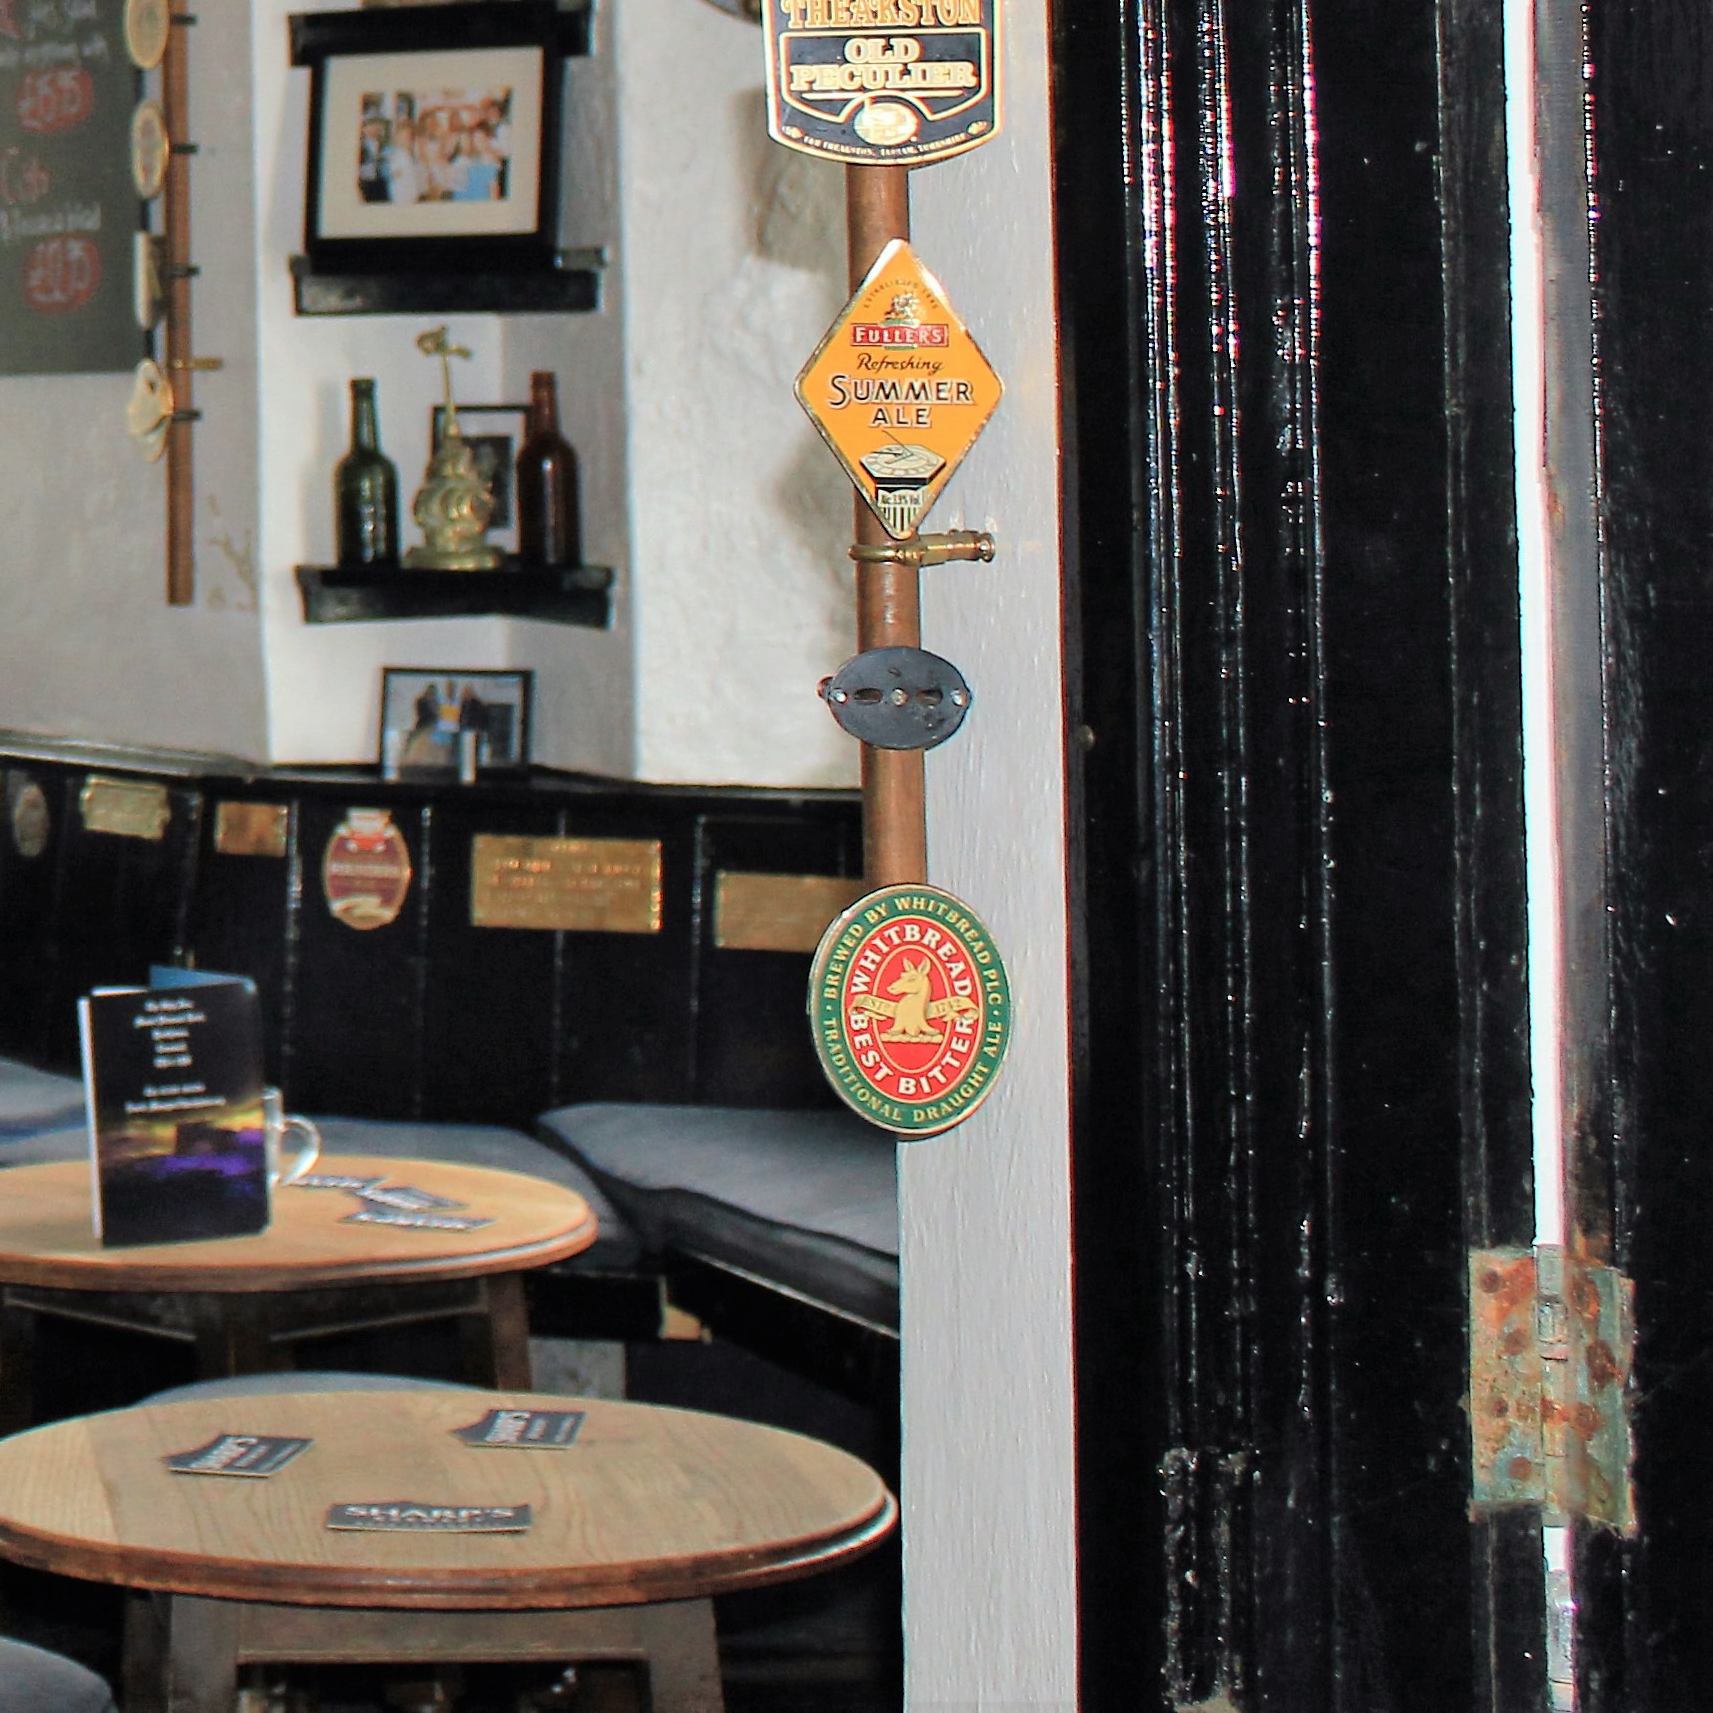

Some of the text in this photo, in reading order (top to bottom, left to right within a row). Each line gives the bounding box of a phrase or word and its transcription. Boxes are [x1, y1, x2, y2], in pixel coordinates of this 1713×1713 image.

[843, 36, 921, 66] OLD
[789, 61, 979, 93] PECULIER
[855, 352, 944, 375] Refreshing
[827, 374, 977, 410] SUMMER
[868, 407, 934, 429] ALE
[823, 922, 864, 999] BREWED
[865, 902, 888, 927] BY
[893, 895, 992, 968] WHITBREAD
[849, 923, 973, 996] WHITBREAD
[823, 1015, 903, 1122] TRADITIONAL
[912, 1062, 992, 1124] DRAUGHT
[848, 1010, 975, 1097] BEST BITTER
